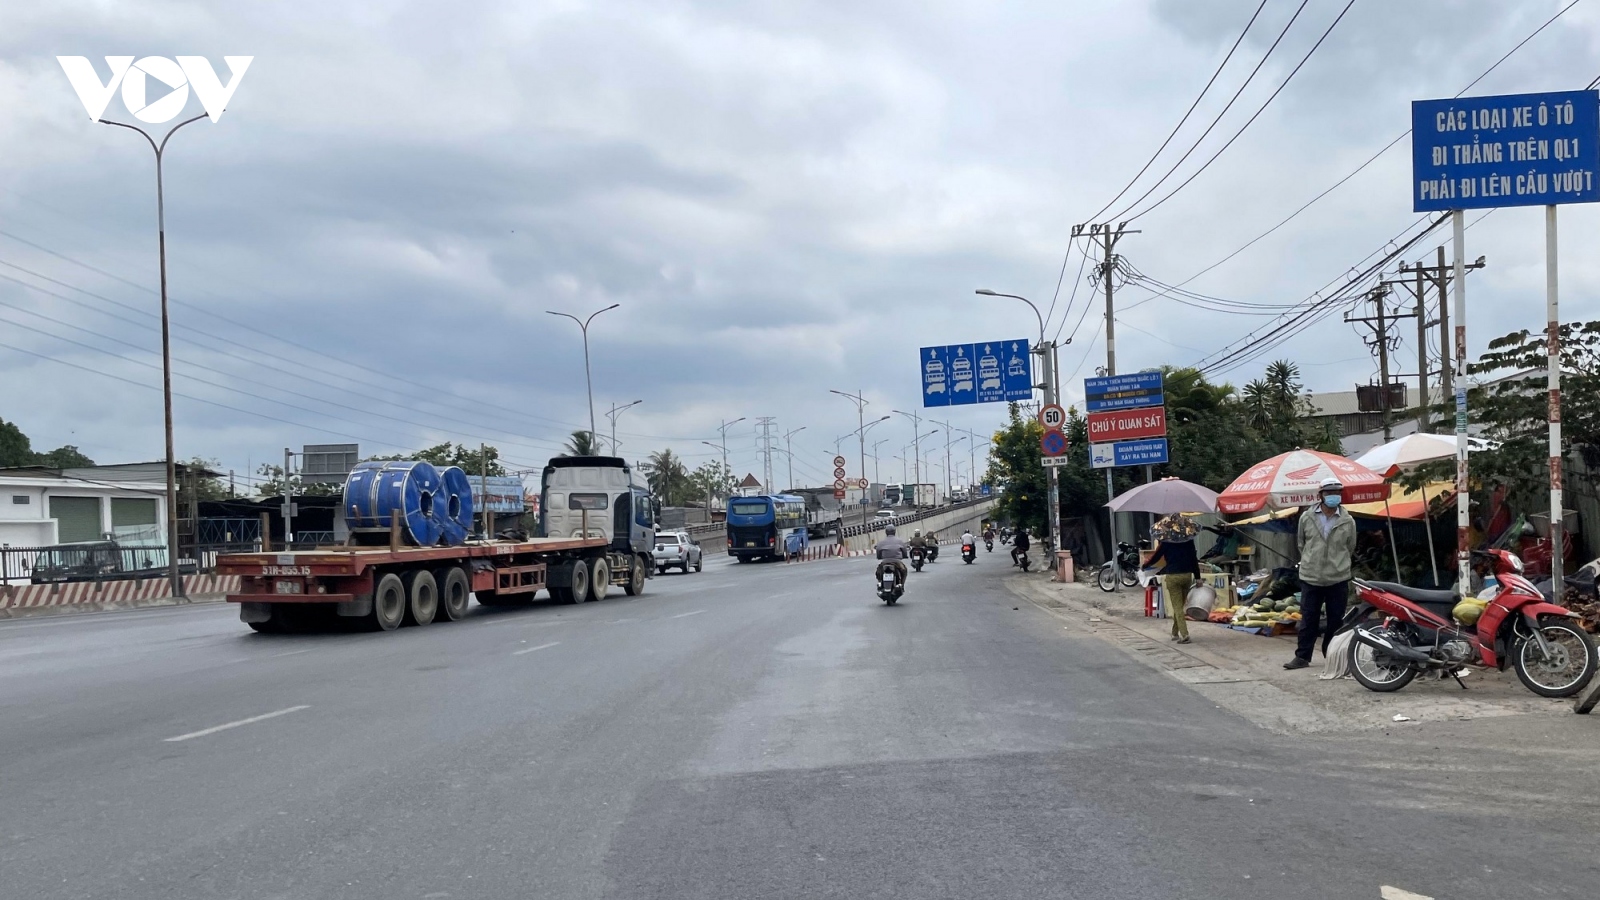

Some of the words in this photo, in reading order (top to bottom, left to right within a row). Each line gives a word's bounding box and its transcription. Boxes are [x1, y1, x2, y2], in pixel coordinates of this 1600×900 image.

[1436, 107, 1466, 132] CÁC
[1472, 108, 1506, 133] LOẠI
[1512, 106, 1532, 128] XE
[1538, 102, 1548, 126] Ô
[1554, 100, 1574, 125] TÔ
[1432, 146, 1448, 166] ĐI
[1453, 134, 1502, 165] THẲNG
[1508, 137, 1548, 162] TRÊN
[1554, 138, 1579, 162] QL1
[1420, 173, 1456, 200] PHẢI
[1461, 178, 1476, 198] ĐI
[1482, 172, 1511, 197] LÊN
[1516, 169, 1548, 195] CẦU
[1553, 168, 1592, 196] VƯỢT
[1046, 411, 1058, 423] 50
[1092, 418, 1109, 433] CHÚ
[1110, 417, 1116, 430] Ý
[1119, 418, 1142, 430] QUAN
[1144, 414, 1161, 428] SÁT
[1231, 480, 1269, 492] YAMAHA
[1340, 472, 1378, 482] YAMAHA
